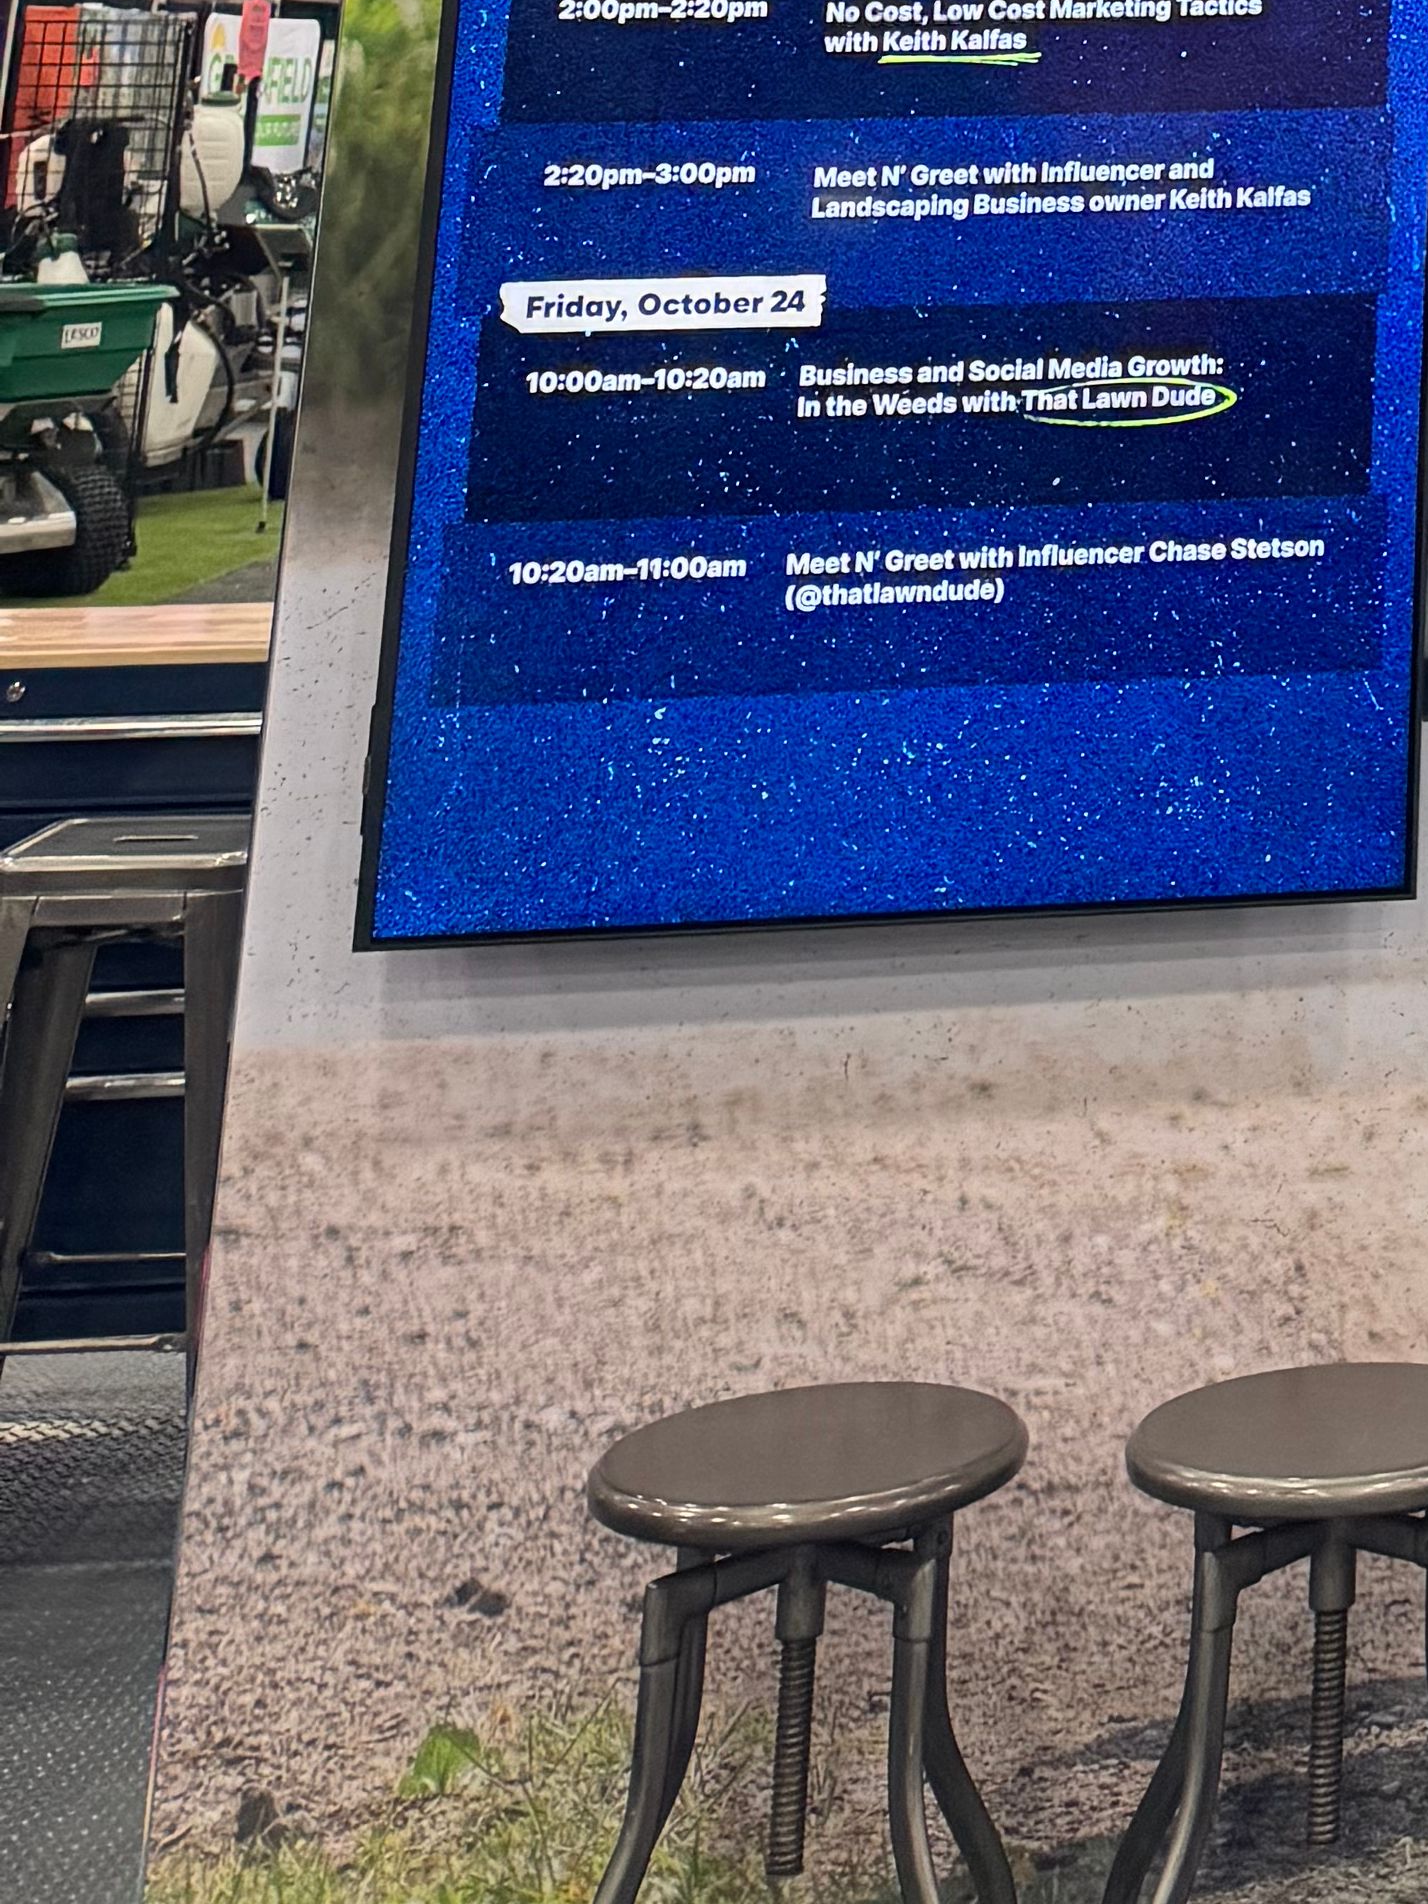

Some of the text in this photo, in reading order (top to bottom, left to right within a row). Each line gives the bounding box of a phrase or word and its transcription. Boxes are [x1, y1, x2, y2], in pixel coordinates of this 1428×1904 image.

[825, 1, 861, 24] No
[864, 0, 930, 26] Cost,
[932, 0, 984, 22] Low
[823, 28, 1028, 54] with Keith Kalfas
[812, 165, 878, 190] Meet
[910, 164, 980, 187] Greet
[982, 162, 1039, 185] with
[1041, 158, 1167, 185] Influencer
[1167, 158, 1216, 180] and
[811, 185, 1313, 222] Landscaping Business owner Keith Kalfas
[525, 290, 807, 323] Friday, October 24
[798, 363, 914, 388] Business
[916, 361, 965, 383] and
[967, 358, 1045, 382] Social
[1048, 356, 1123, 380] Media
[1126, 355, 1225, 378] Growth:
[796, 384, 1218, 418] In the Weeds with That Lawn Dude
[785, 552, 852, 577] Meet
[884, 549, 956, 574] Greet
[958, 546, 1014, 571] with
[1017, 543, 1147, 568] Influencer
[1148, 539, 1228, 564] Chase
[1230, 537, 1326, 561] Stetson
[784, 577, 1006, 613] (@thatlawndude)
